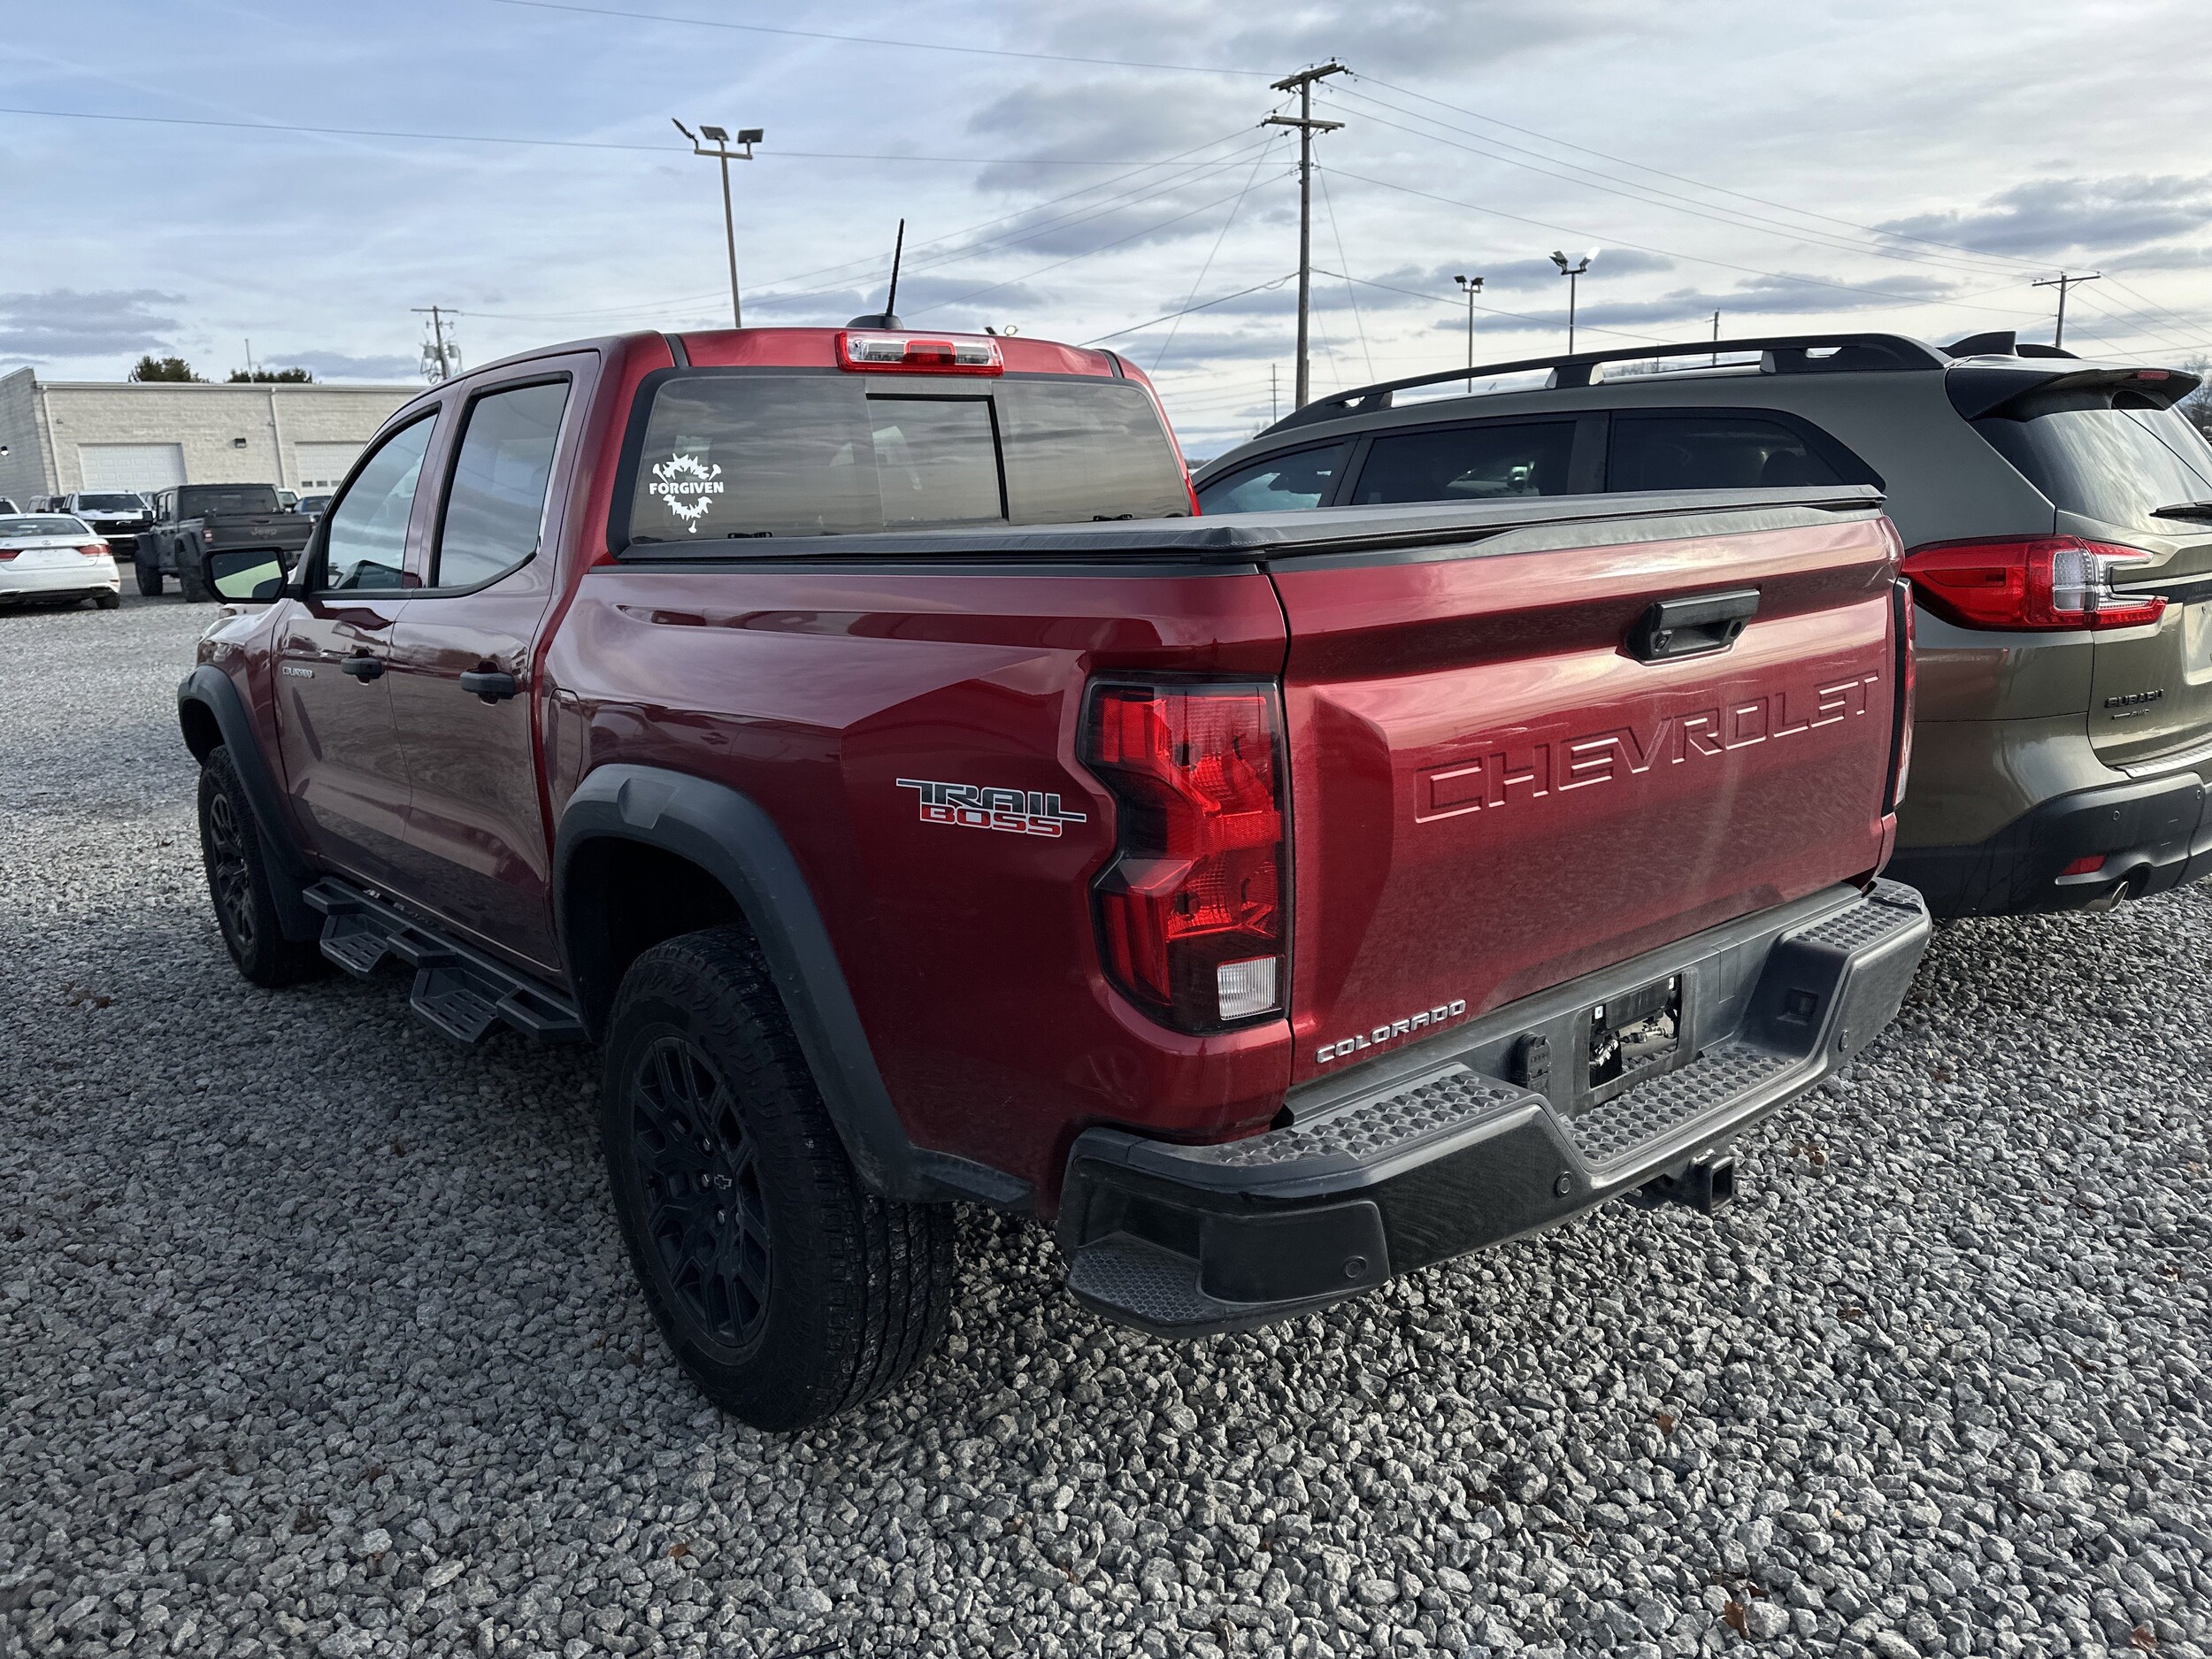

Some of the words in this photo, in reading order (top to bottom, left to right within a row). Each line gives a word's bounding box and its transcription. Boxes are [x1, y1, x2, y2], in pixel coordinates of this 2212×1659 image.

[649, 481, 725, 495] FORGIVEN
[2104, 688, 2164, 709] SUBARU
[1416, 670, 1879, 824] CHEVROLET
[896, 778, 1087, 823] TRAIL
[920, 803, 1063, 838] BOSS
[1317, 999, 1466, 1064] COLORADO
